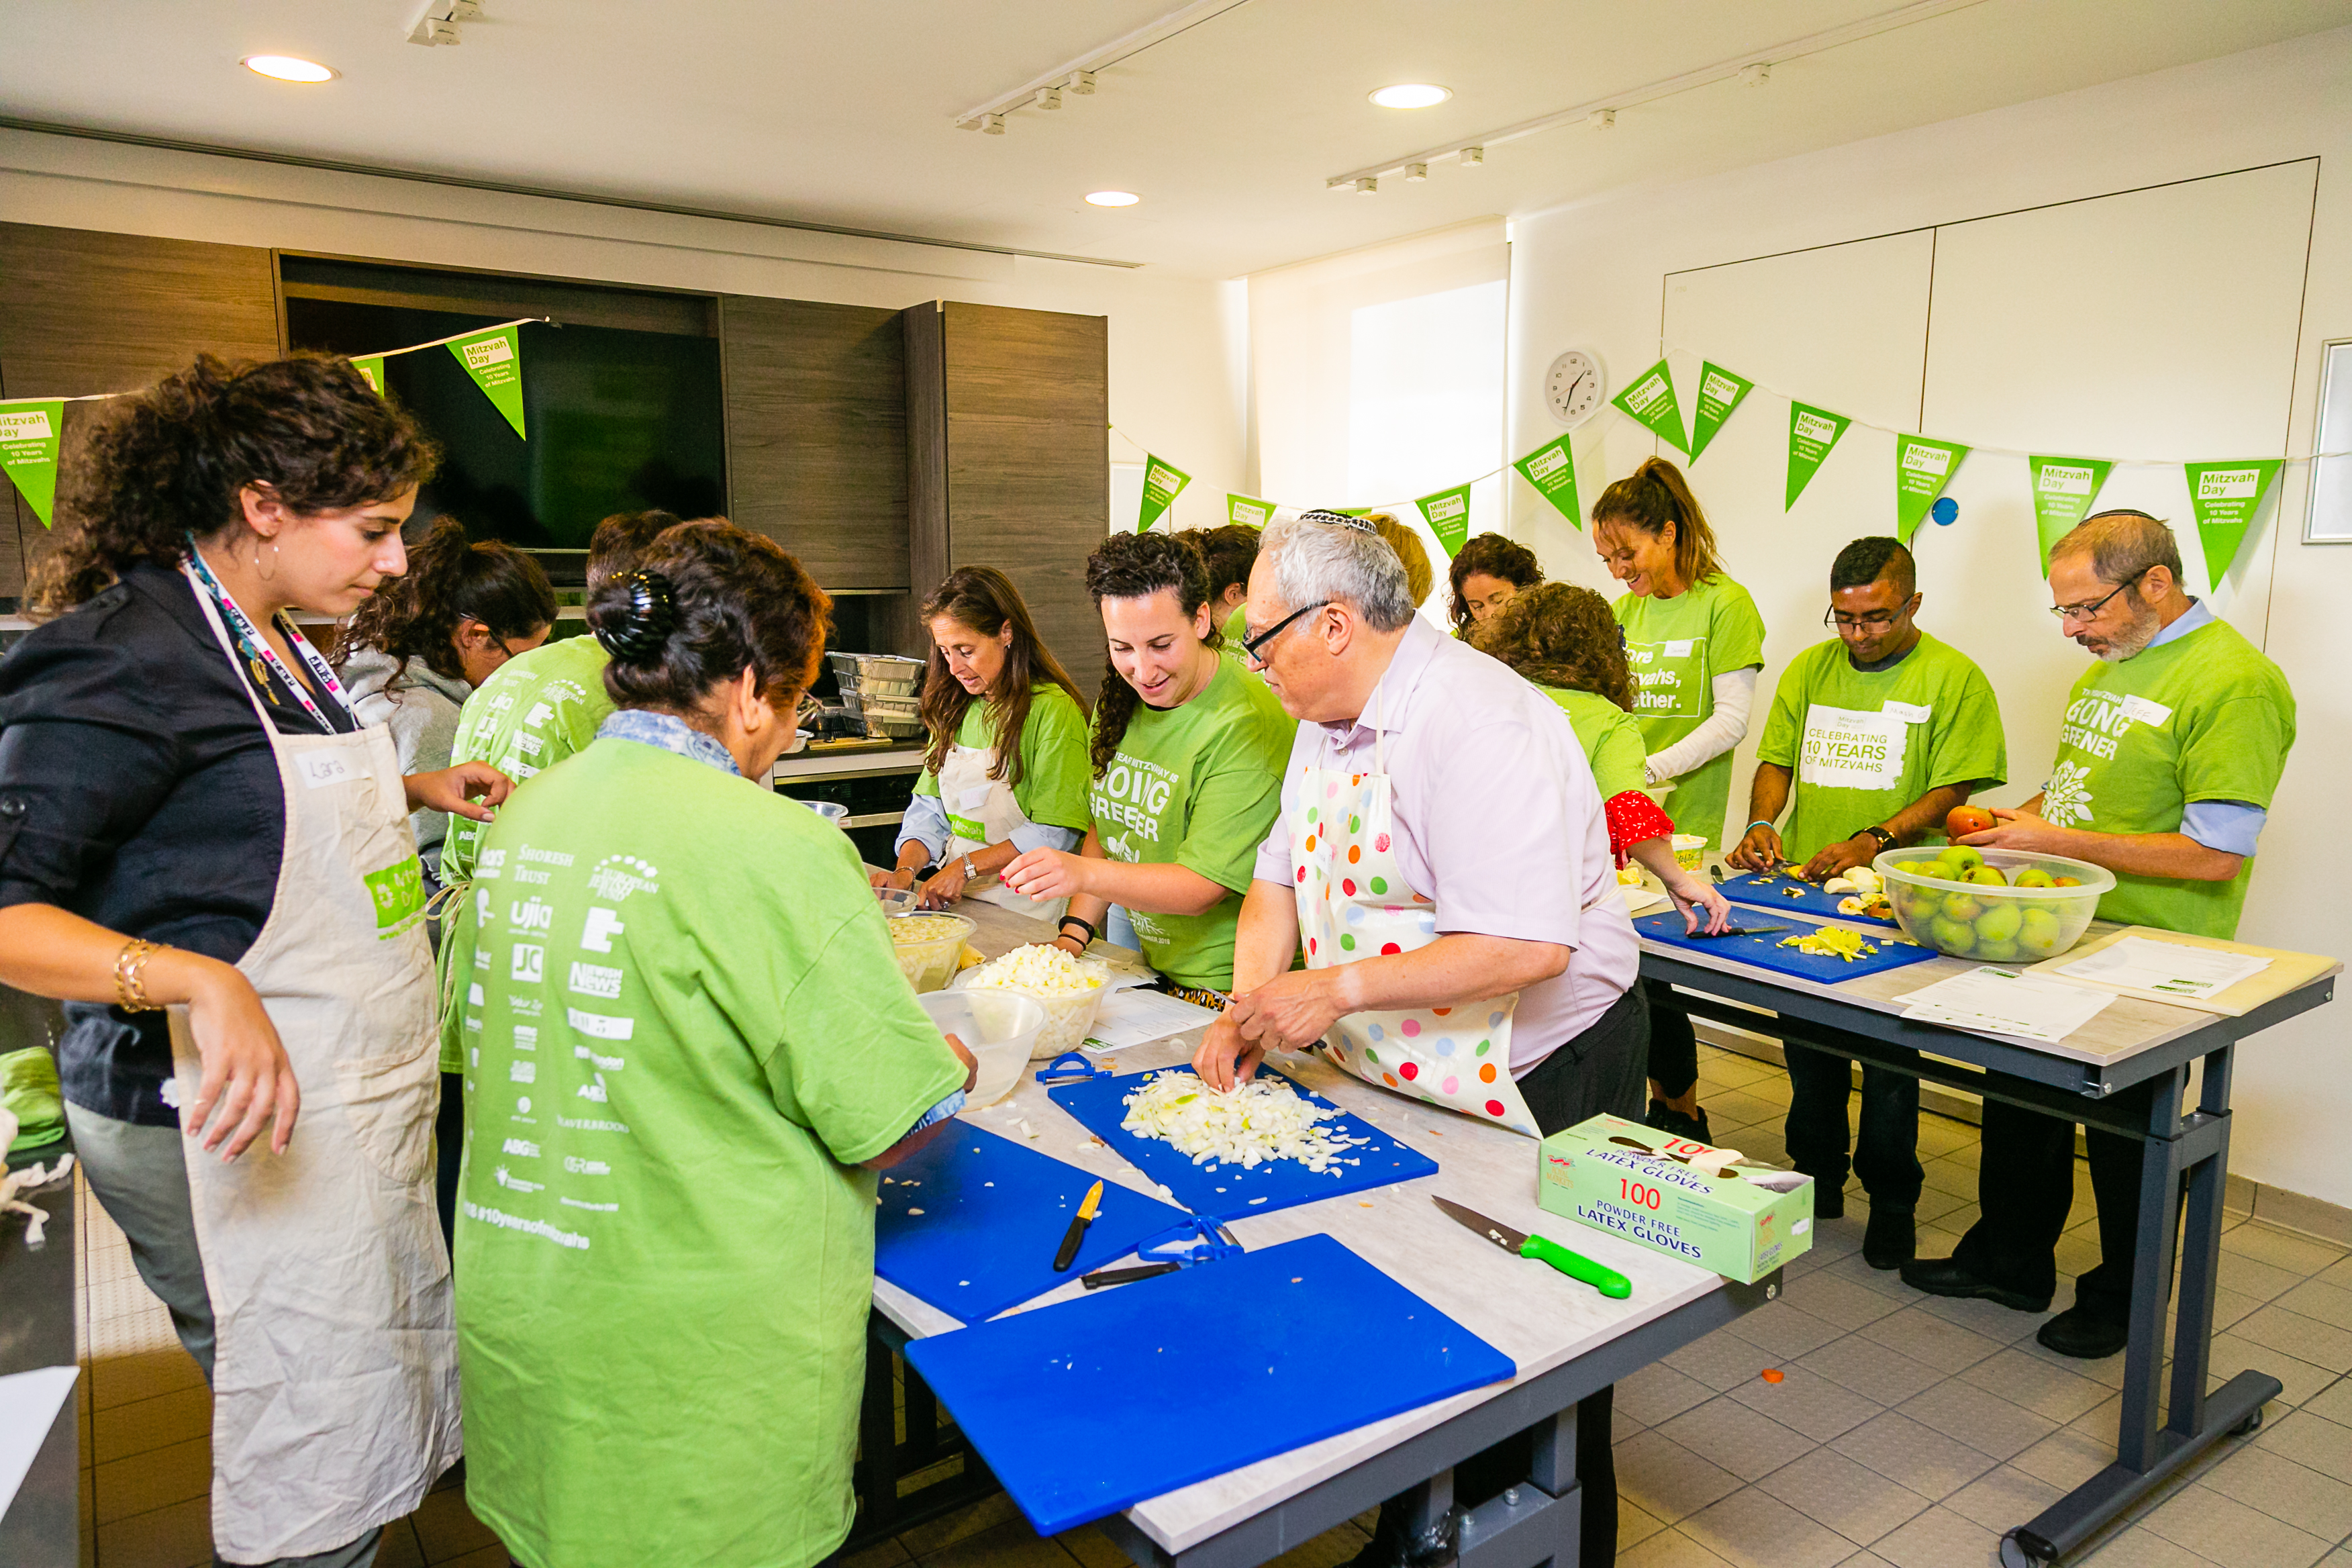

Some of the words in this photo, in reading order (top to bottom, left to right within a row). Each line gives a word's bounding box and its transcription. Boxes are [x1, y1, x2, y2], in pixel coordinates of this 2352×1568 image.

[466, 340, 507, 356] Mitzvah
[470, 355, 489, 365] Day
[479, 364, 511, 375] Celebrating
[491, 377, 516, 386] Mitzvahs
[1705, 383, 1719, 395] Day
[1708, 375, 1736, 394] Mitzvah
[1628, 377, 1661, 403] Mitzvah
[1632, 395, 1649, 410] Day
[0, 414, 45, 426] itzvah
[1800, 414, 1833, 432] Mitzvah
[0, 428, 19, 438] ay
[1798, 423, 1814, 436] Day
[2, 442, 46, 450] Celebrating
[1908, 446, 1947, 462] Mitzvah
[1530, 450, 1562, 471] Mitzvah
[1906, 456, 1924, 469] Day
[1150, 473, 1163, 485] Day
[1153, 467, 1178, 485] Mitzvah
[1533, 465, 1549, 477] Day
[2045, 468, 2090, 480] Mitzvah
[2203, 473, 2255, 483] Mitzvah
[2043, 478, 2065, 490] Day
[2202, 485, 2226, 496] Day
[1236, 504, 1263, 516] Mitzvah
[1430, 497, 1461, 511] Mitzvah
[1235, 511, 1248, 521] Day
[1432, 509, 1447, 519] Day
[1623, 644, 1653, 664] ore
[309, 656, 332, 683] JW3
[1635, 668, 1681, 688] vahs,
[1633, 691, 1681, 708] ther.
[1809, 728, 1888, 744] CELEBRATING
[1806, 740, 1820, 754] 10
[1827, 742, 1886, 761] YEARS
[1805, 755, 1817, 765] OF
[1819, 758, 1883, 773] MITZVAHS
[1169, 773, 1179, 783] IS
[518, 844, 575, 867] SHORESH
[514, 865, 551, 885] TRUST
[509, 895, 553, 929] ujia
[516, 948, 542, 973] JC
[502, 1138, 530, 1156] ABG
[1663, 1138, 1716, 1155] 10
[1586, 1148, 1639, 1169] LATEX
[1643, 1167, 1714, 1194] GLOVES
[1615, 1149, 1666, 1168] POWDER
[1669, 1166, 1700, 1179] FREE
[1552, 1167, 1568, 1178] ROYAL
[1547, 1173, 1574, 1189] MARKETS
[1621, 1179, 1661, 1210] 100
[1597, 1199, 1646, 1225] POWDER
[1651, 1219, 1681, 1237] FREE
[1578, 1205, 1627, 1232] LATEX
[1634, 1226, 1701, 1259] GLOVES
